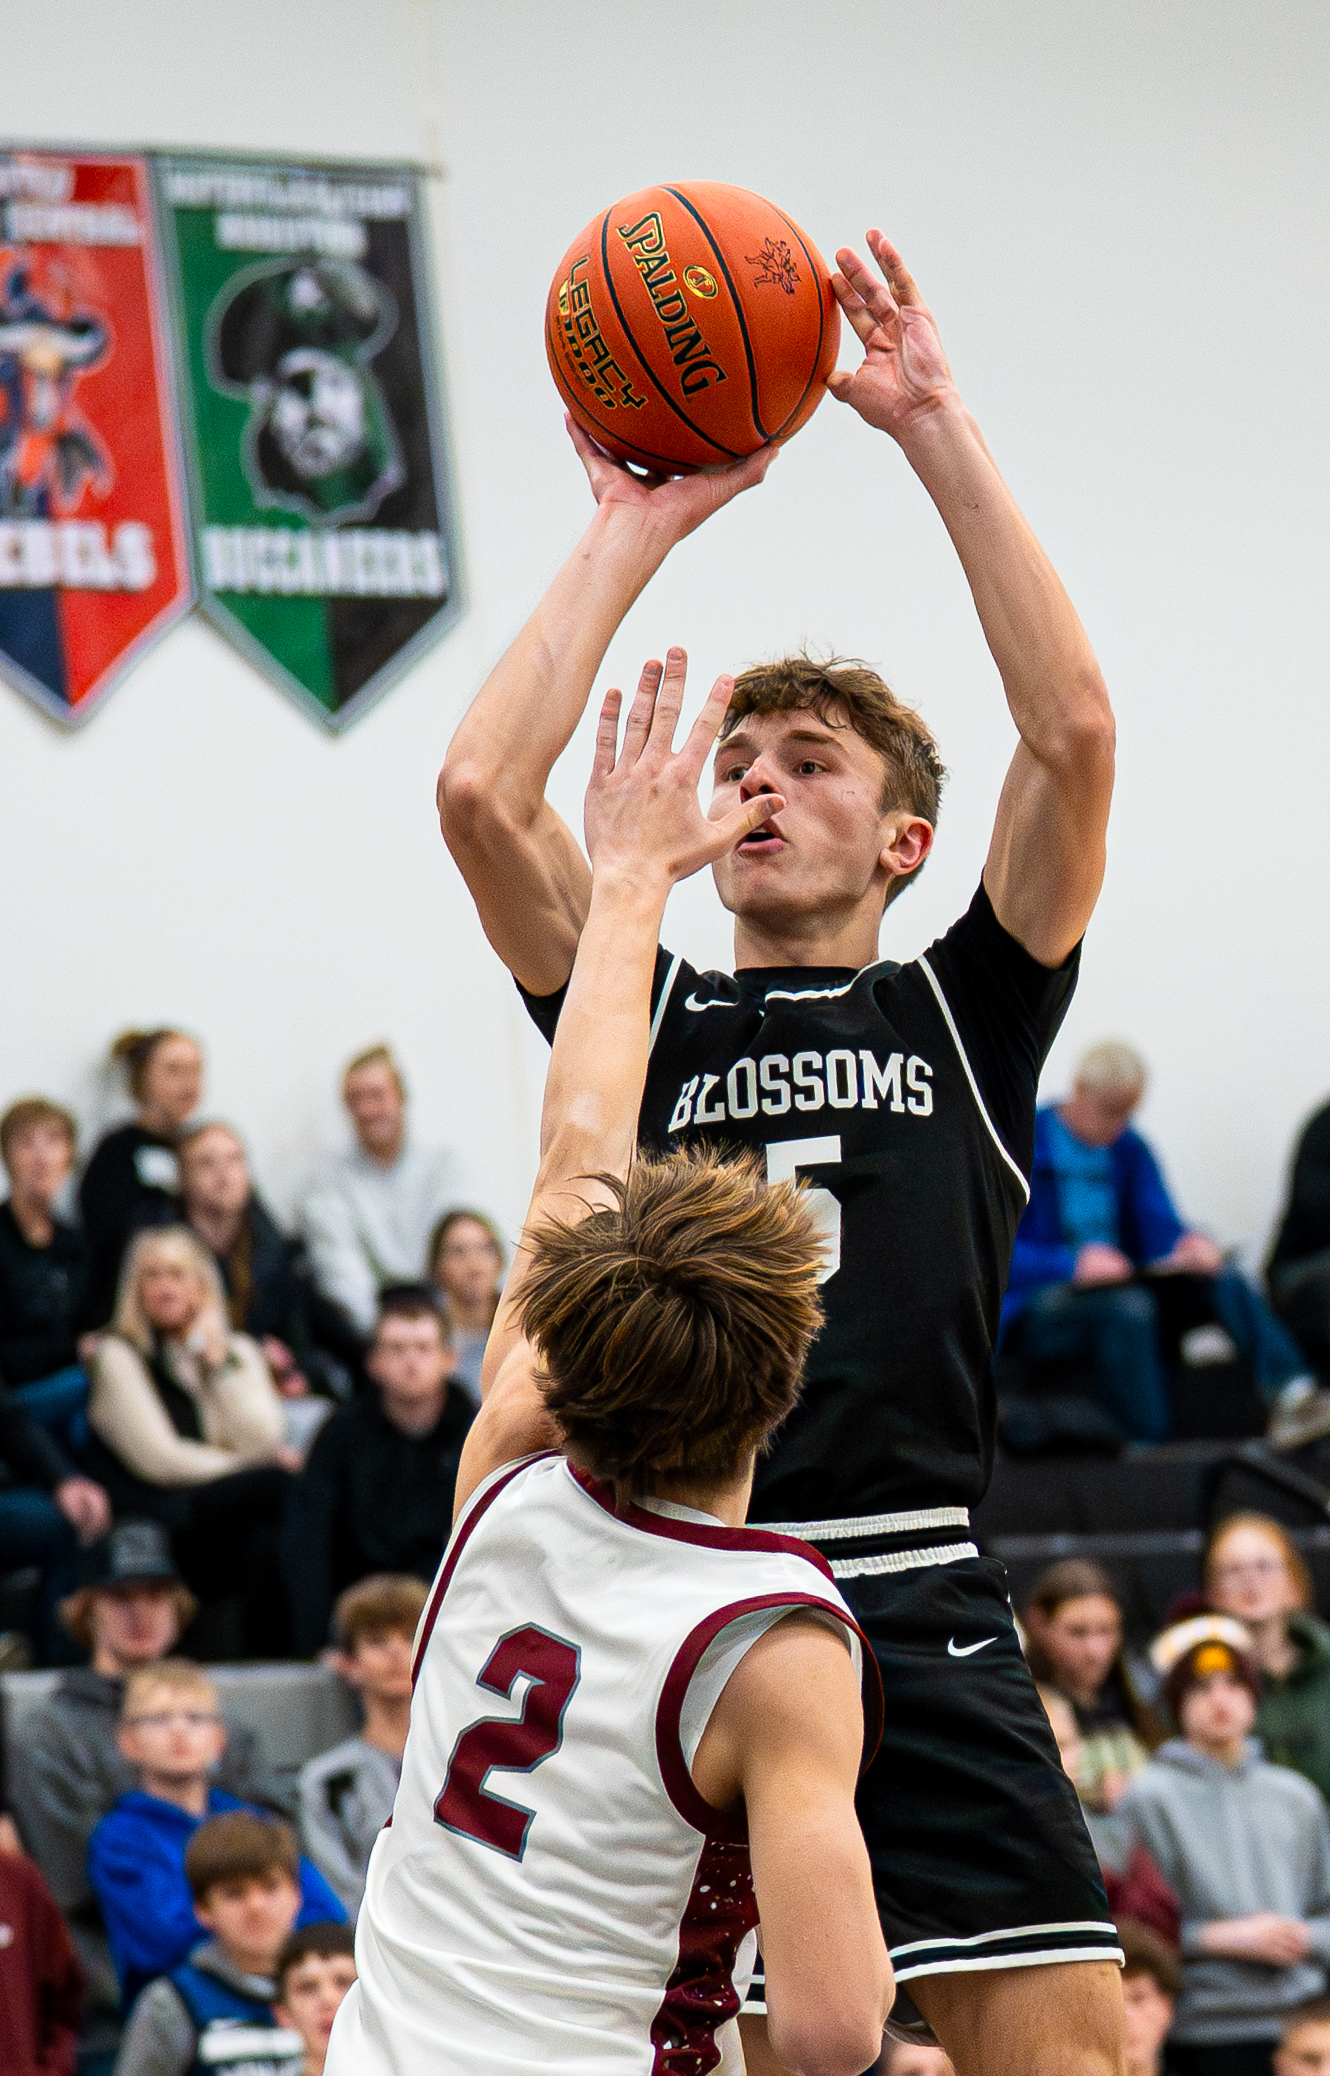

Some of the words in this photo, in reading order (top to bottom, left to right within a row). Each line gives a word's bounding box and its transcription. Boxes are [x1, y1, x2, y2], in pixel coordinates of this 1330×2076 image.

[570, 255, 649, 409] LEGACY
[616, 211, 728, 402] SPALDING
[667, 1049, 934, 1133] BLOSSOMS
[765, 1135, 842, 1285] 5
[433, 1621, 582, 1863] 2
